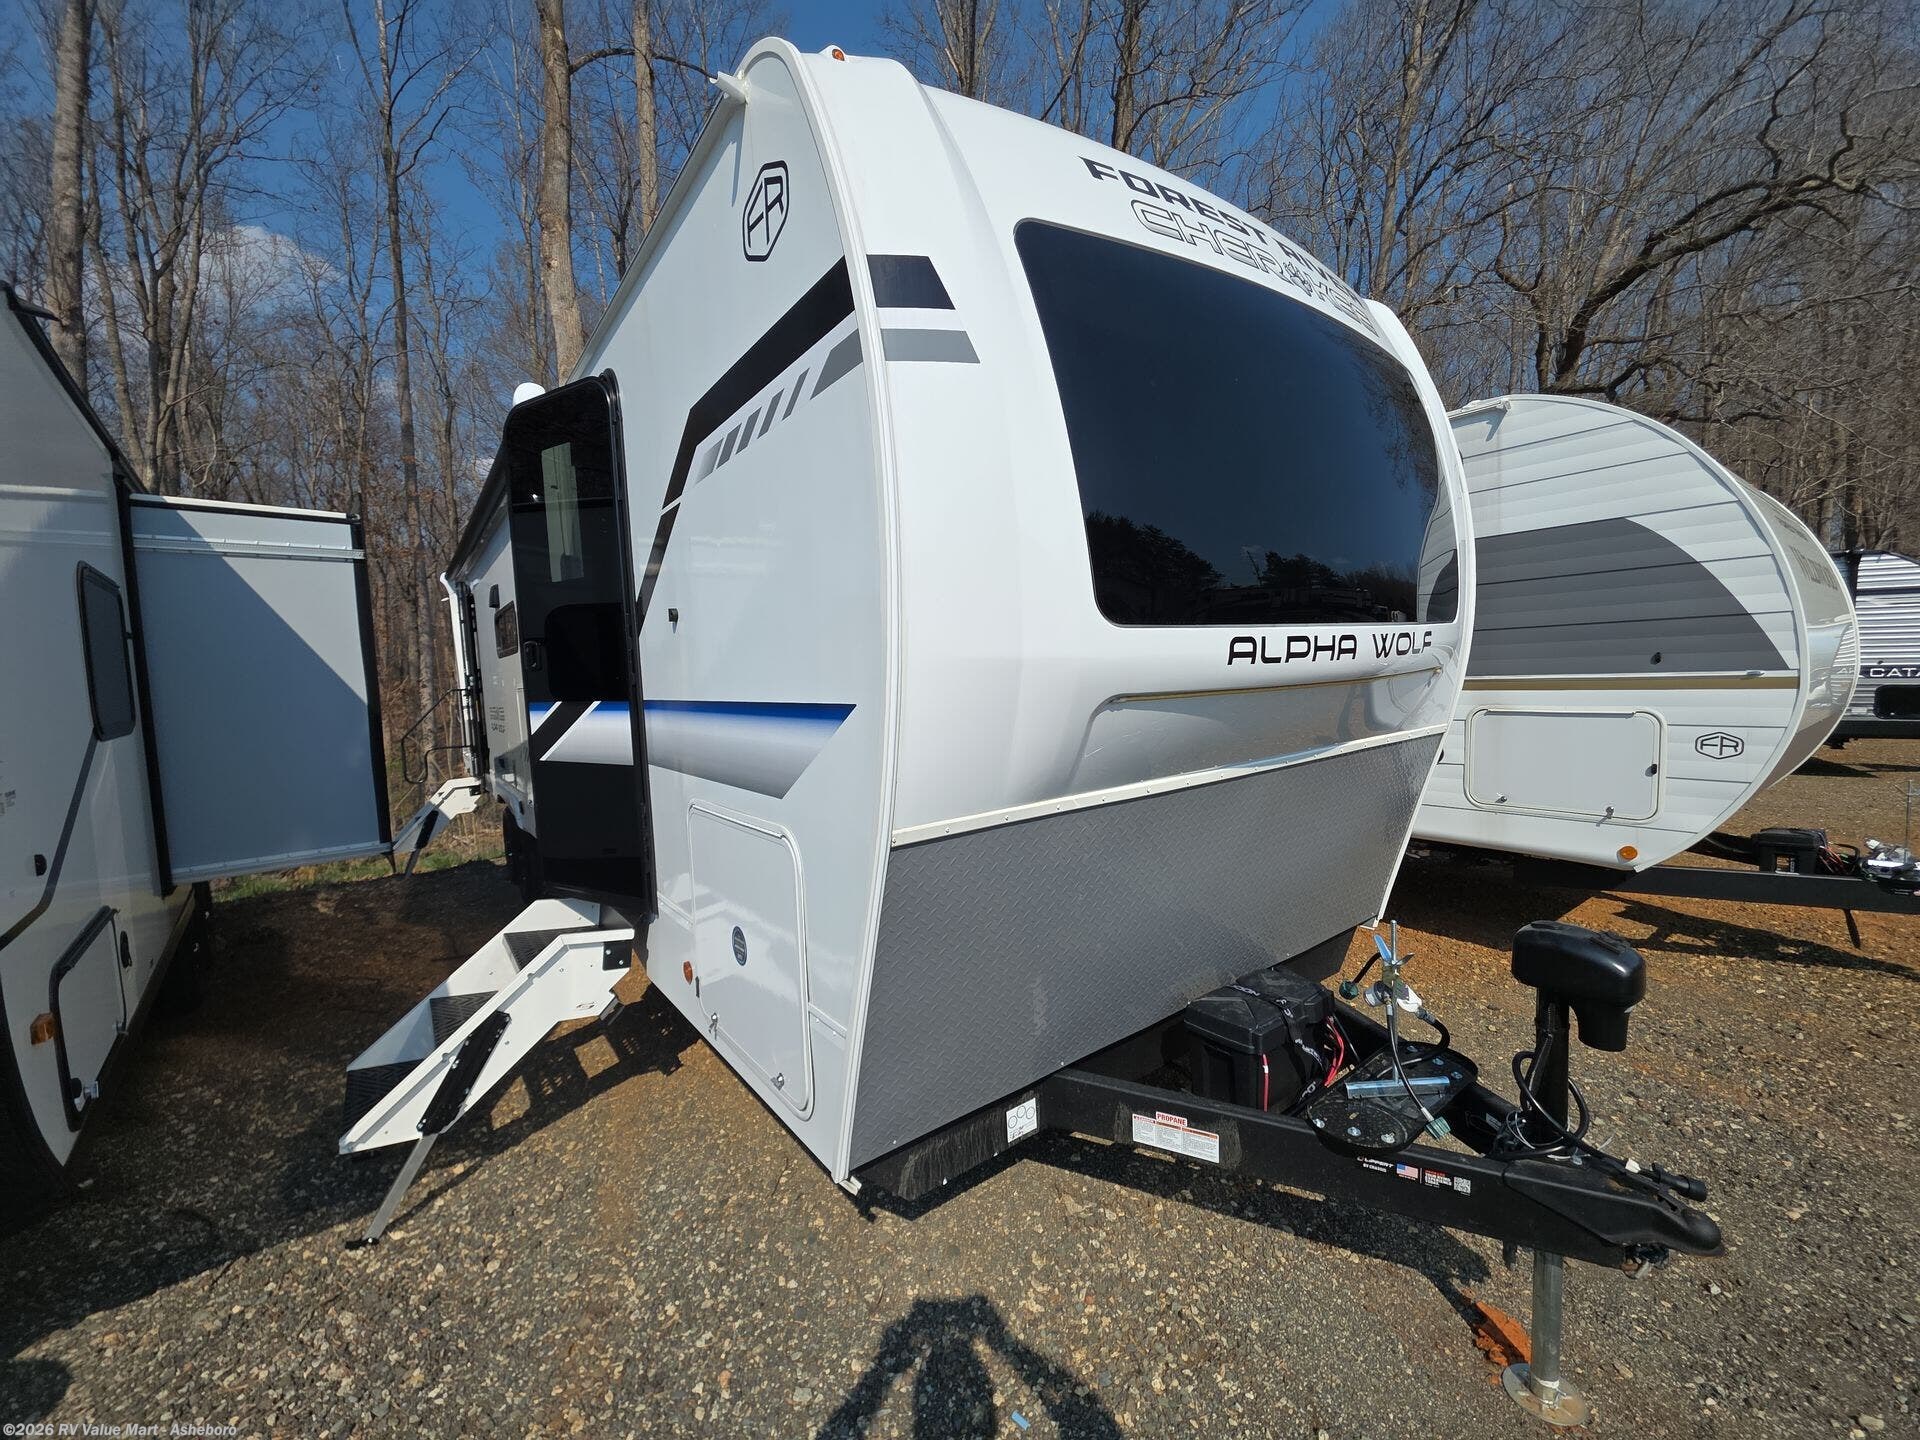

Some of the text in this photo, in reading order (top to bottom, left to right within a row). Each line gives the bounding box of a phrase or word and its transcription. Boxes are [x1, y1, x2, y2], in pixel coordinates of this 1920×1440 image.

[1078, 156, 1267, 246] FOREST
[1227, 630, 1433, 666] ALPHA WOLF
[1156, 1112, 1187, 1126] PROPANE
